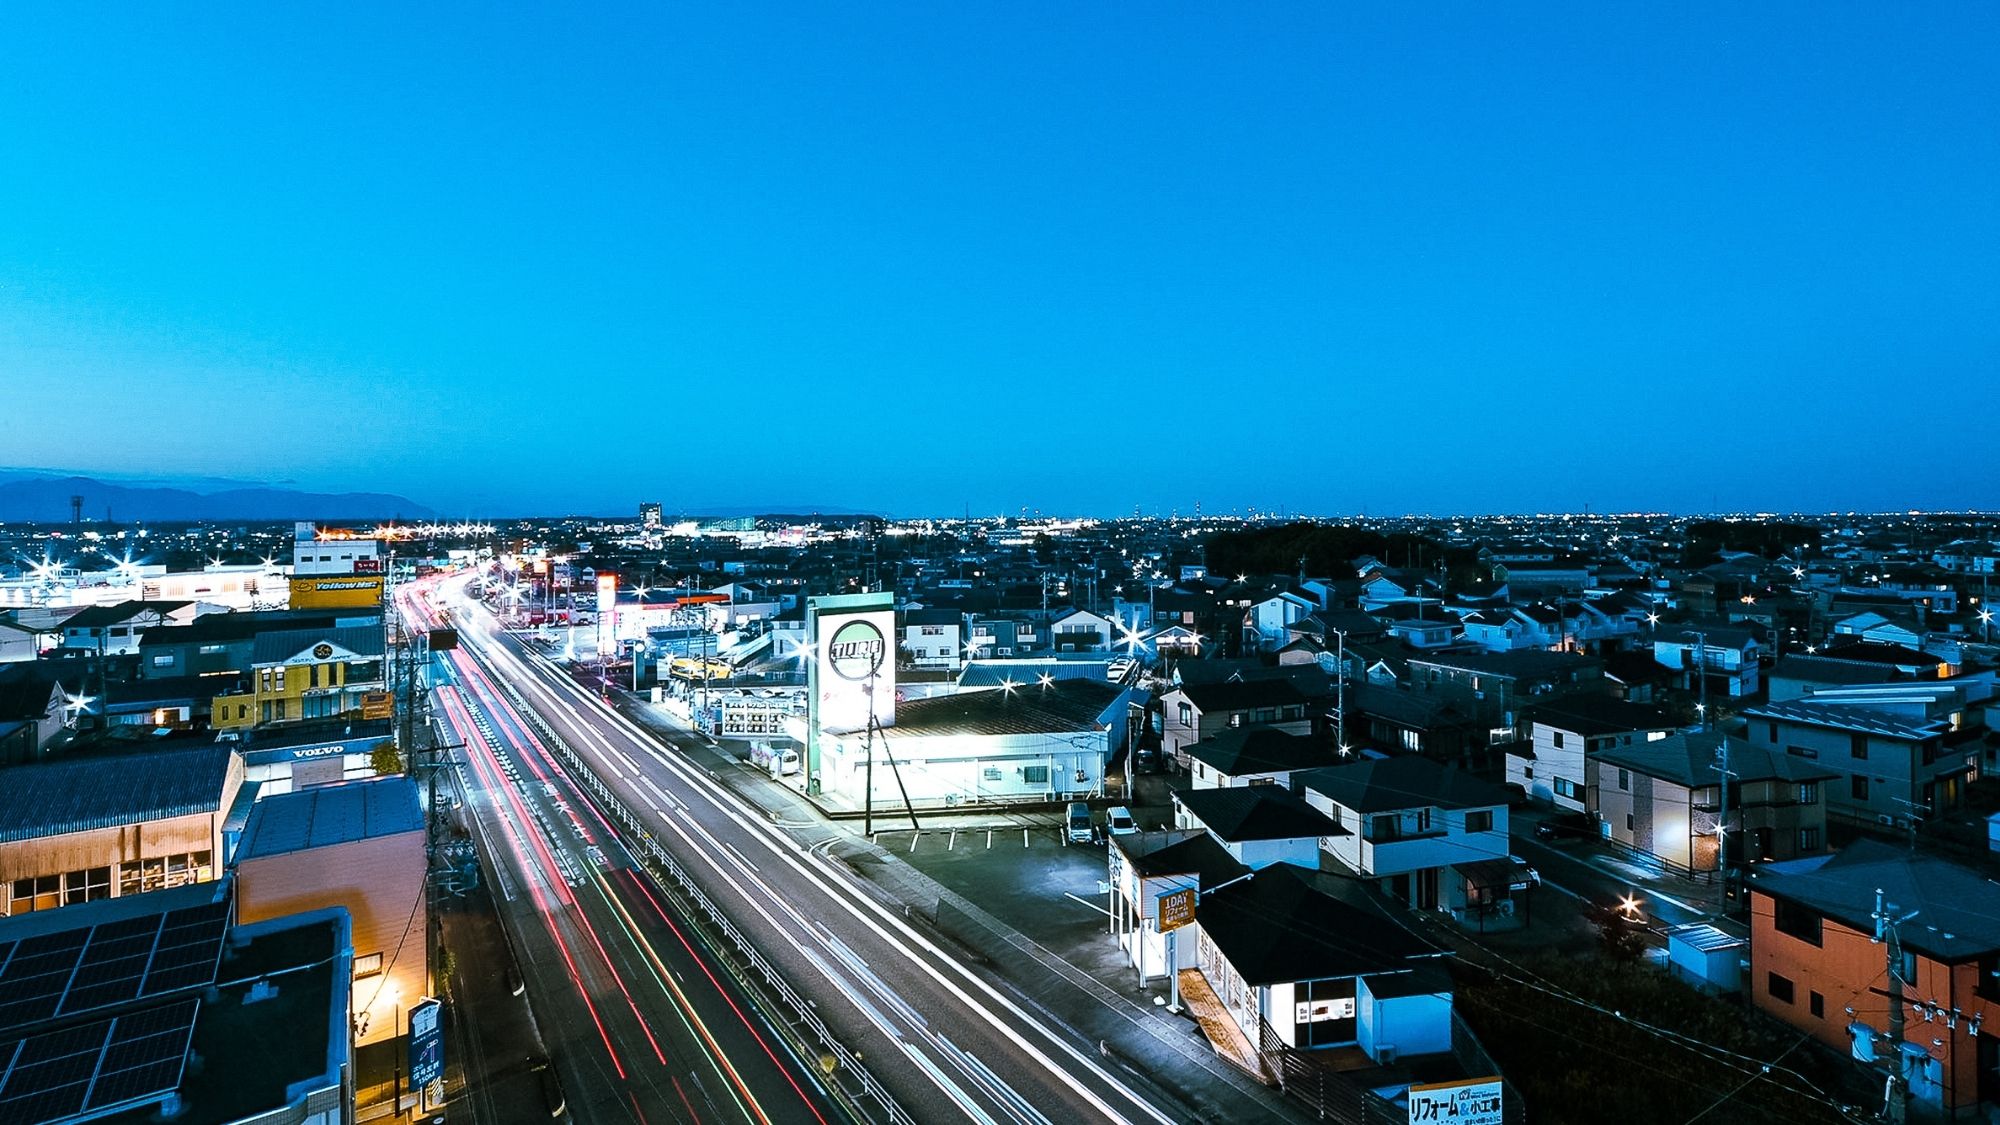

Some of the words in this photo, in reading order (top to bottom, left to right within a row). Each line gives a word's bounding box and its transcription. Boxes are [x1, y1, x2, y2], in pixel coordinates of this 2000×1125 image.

[316, 582, 357, 590] Yellow
[293, 746, 344, 758] VOLVO
[1165, 892, 1188, 909] 1DAY
